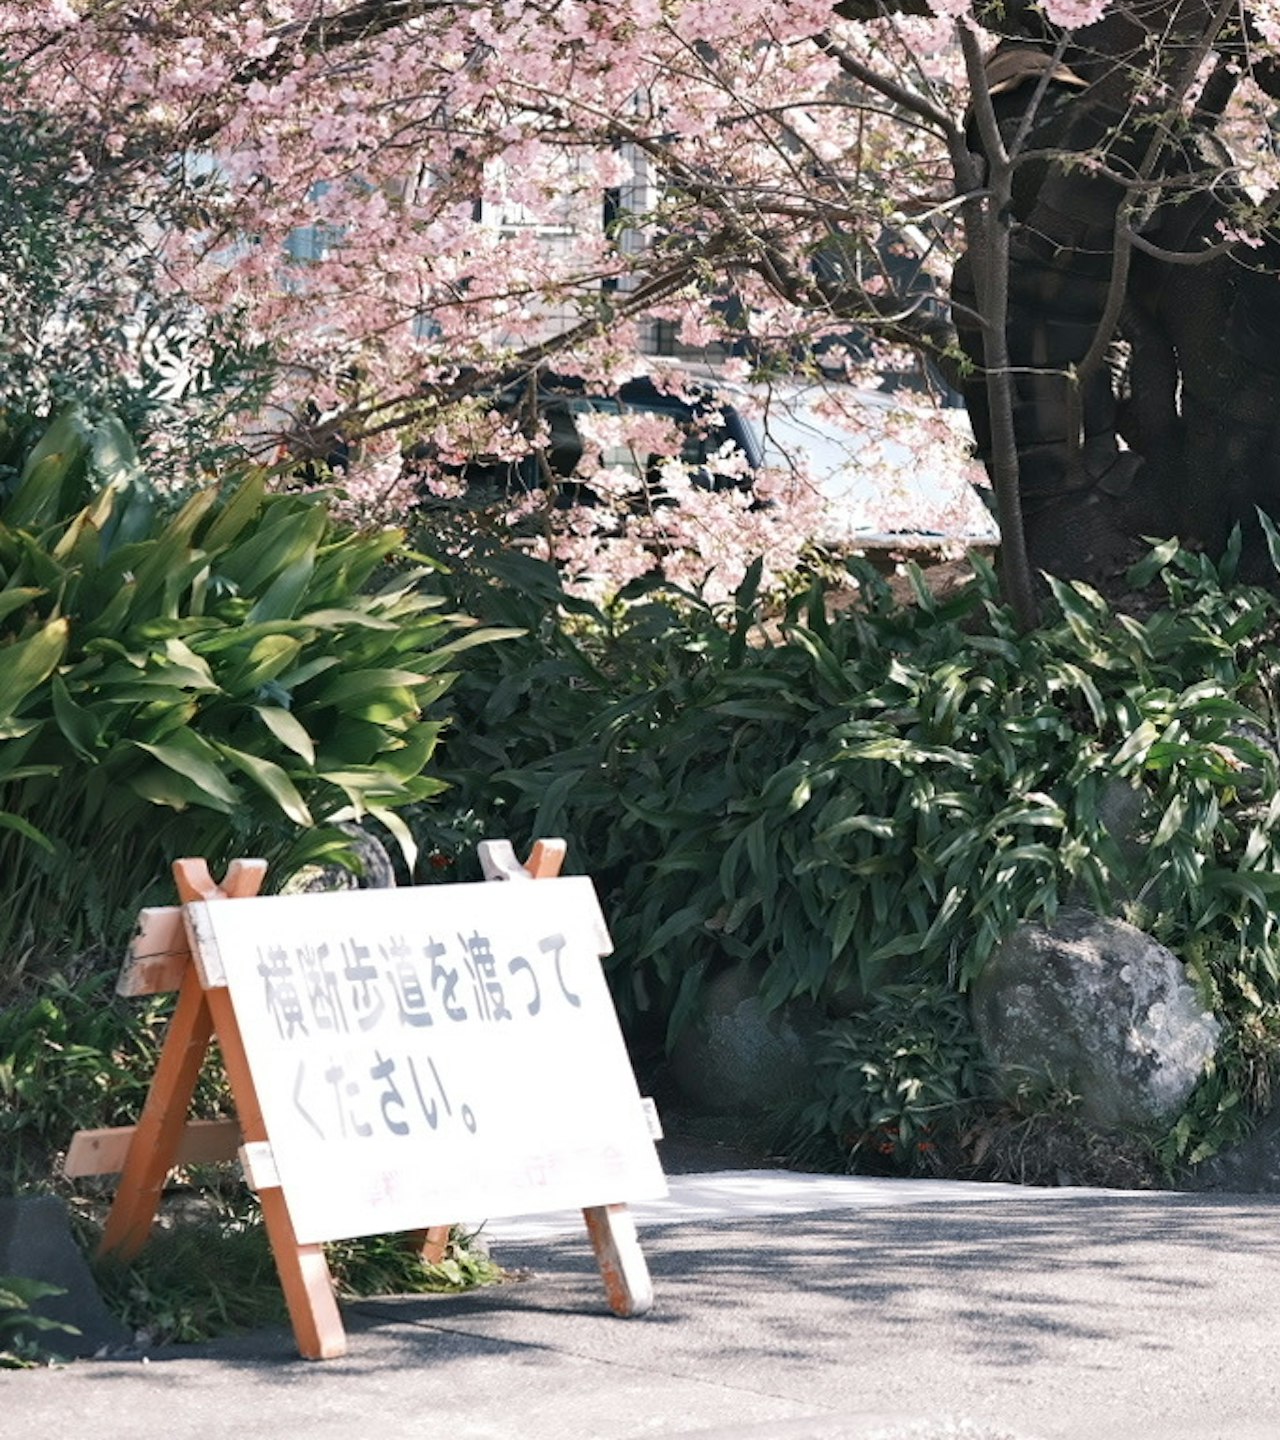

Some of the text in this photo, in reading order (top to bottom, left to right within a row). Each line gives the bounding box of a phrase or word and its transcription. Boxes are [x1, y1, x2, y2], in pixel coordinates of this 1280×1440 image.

[256, 930, 582, 1041] 横断歩道を渡って
[293, 1049, 477, 1141] ください。
